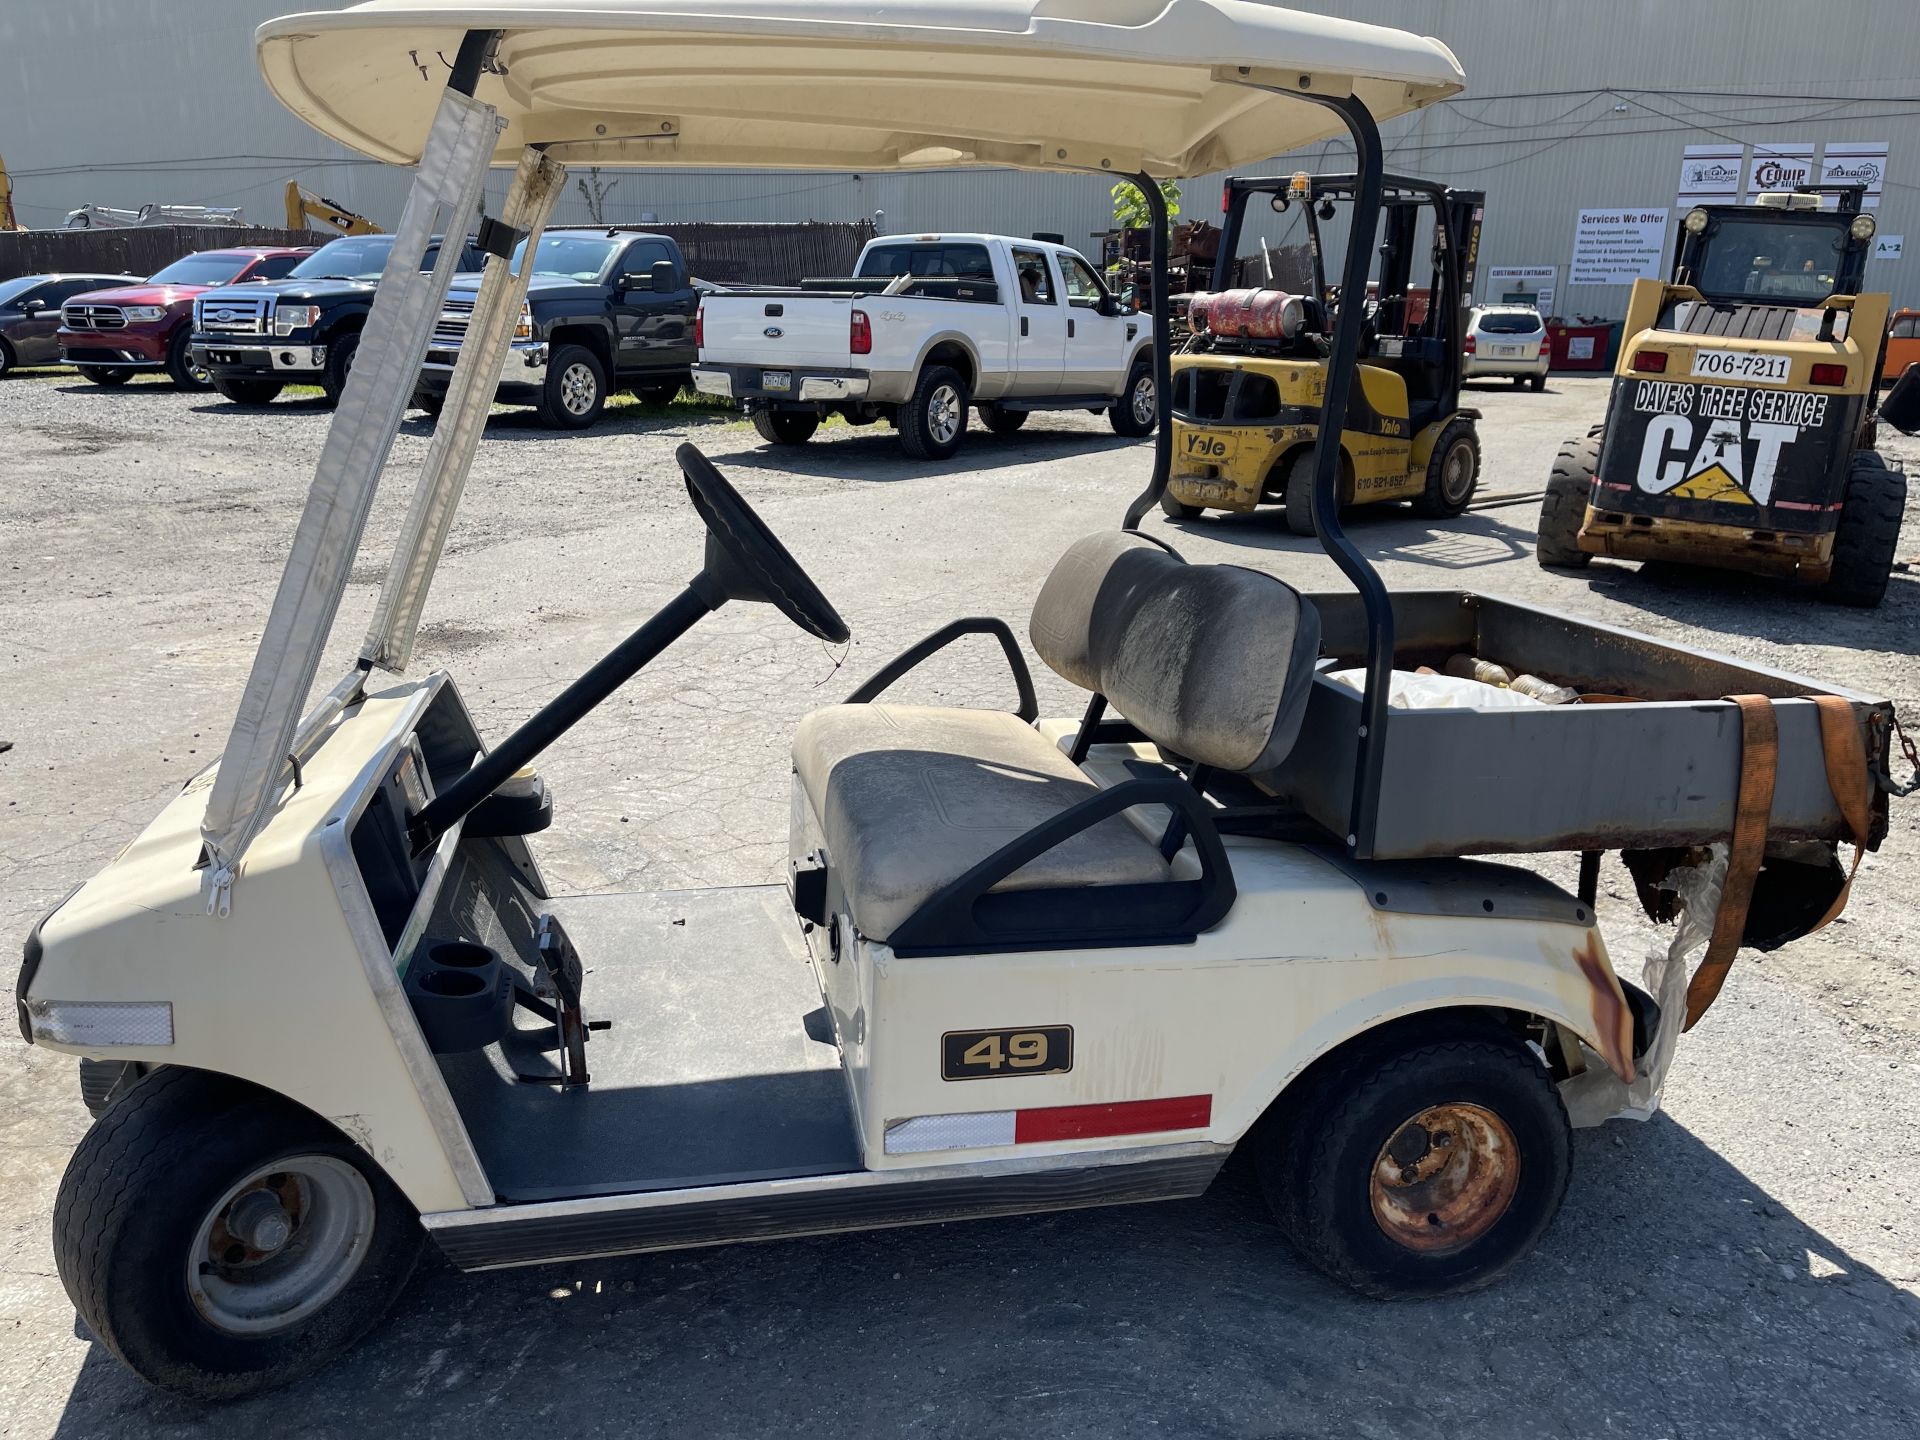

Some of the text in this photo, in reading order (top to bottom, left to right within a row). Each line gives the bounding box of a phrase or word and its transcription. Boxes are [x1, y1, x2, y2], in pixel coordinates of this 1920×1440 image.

[1766, 169, 1805, 181] EQUIP
[336, 217, 348, 228] CAT
[1581, 214, 1664, 224] Services We Offer
[1877, 243, 1901, 252] A-2
[1698, 354, 1786, 379] 706-7211
[1634, 380, 1828, 427] DAVE'S TREE SERVICE
[1381, 418, 1401, 434] Yale
[1188, 434, 1226, 456] Yale
[1637, 414, 1799, 507] CAT
[964, 1034, 1048, 1069] 49
